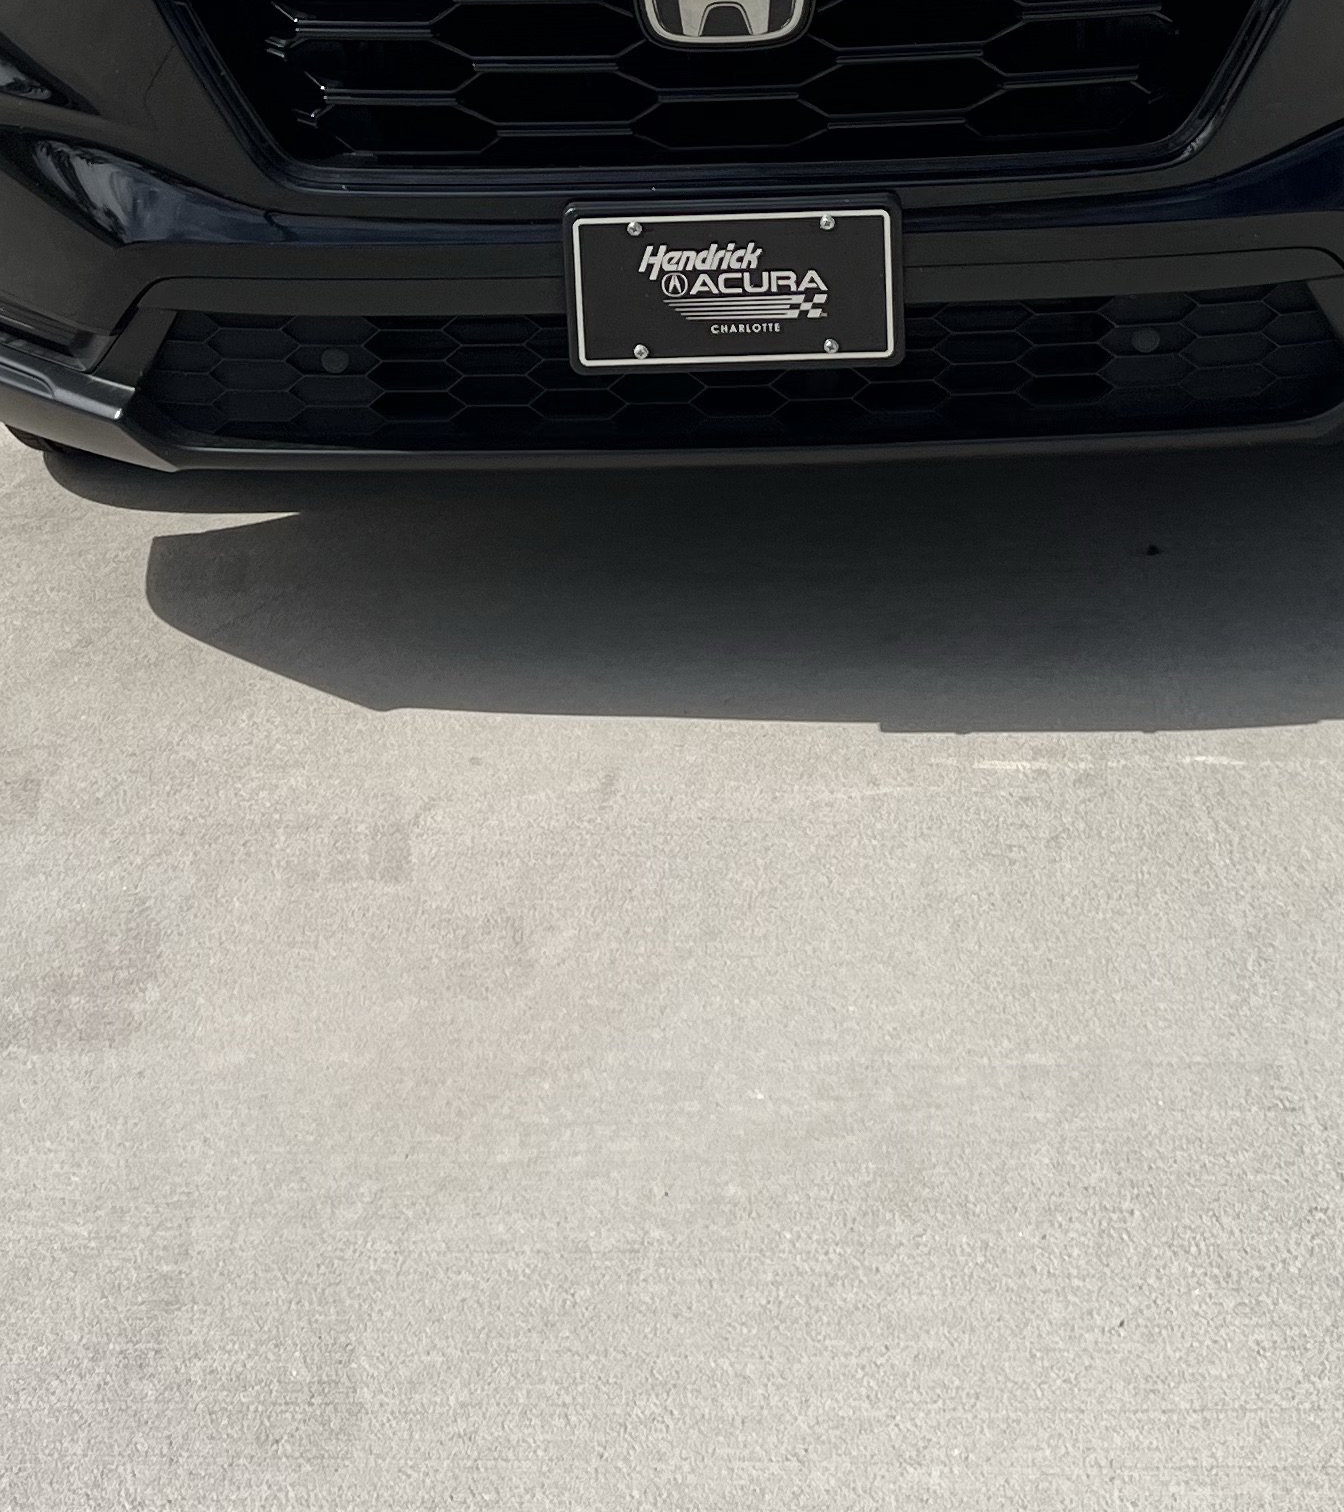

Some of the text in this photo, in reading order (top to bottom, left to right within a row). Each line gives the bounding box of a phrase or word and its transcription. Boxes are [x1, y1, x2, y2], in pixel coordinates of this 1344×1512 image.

[639, 242, 762, 281] Hendrick
[690, 270, 828, 295] ACURA
[710, 322, 781, 334] CHARLOTTE
